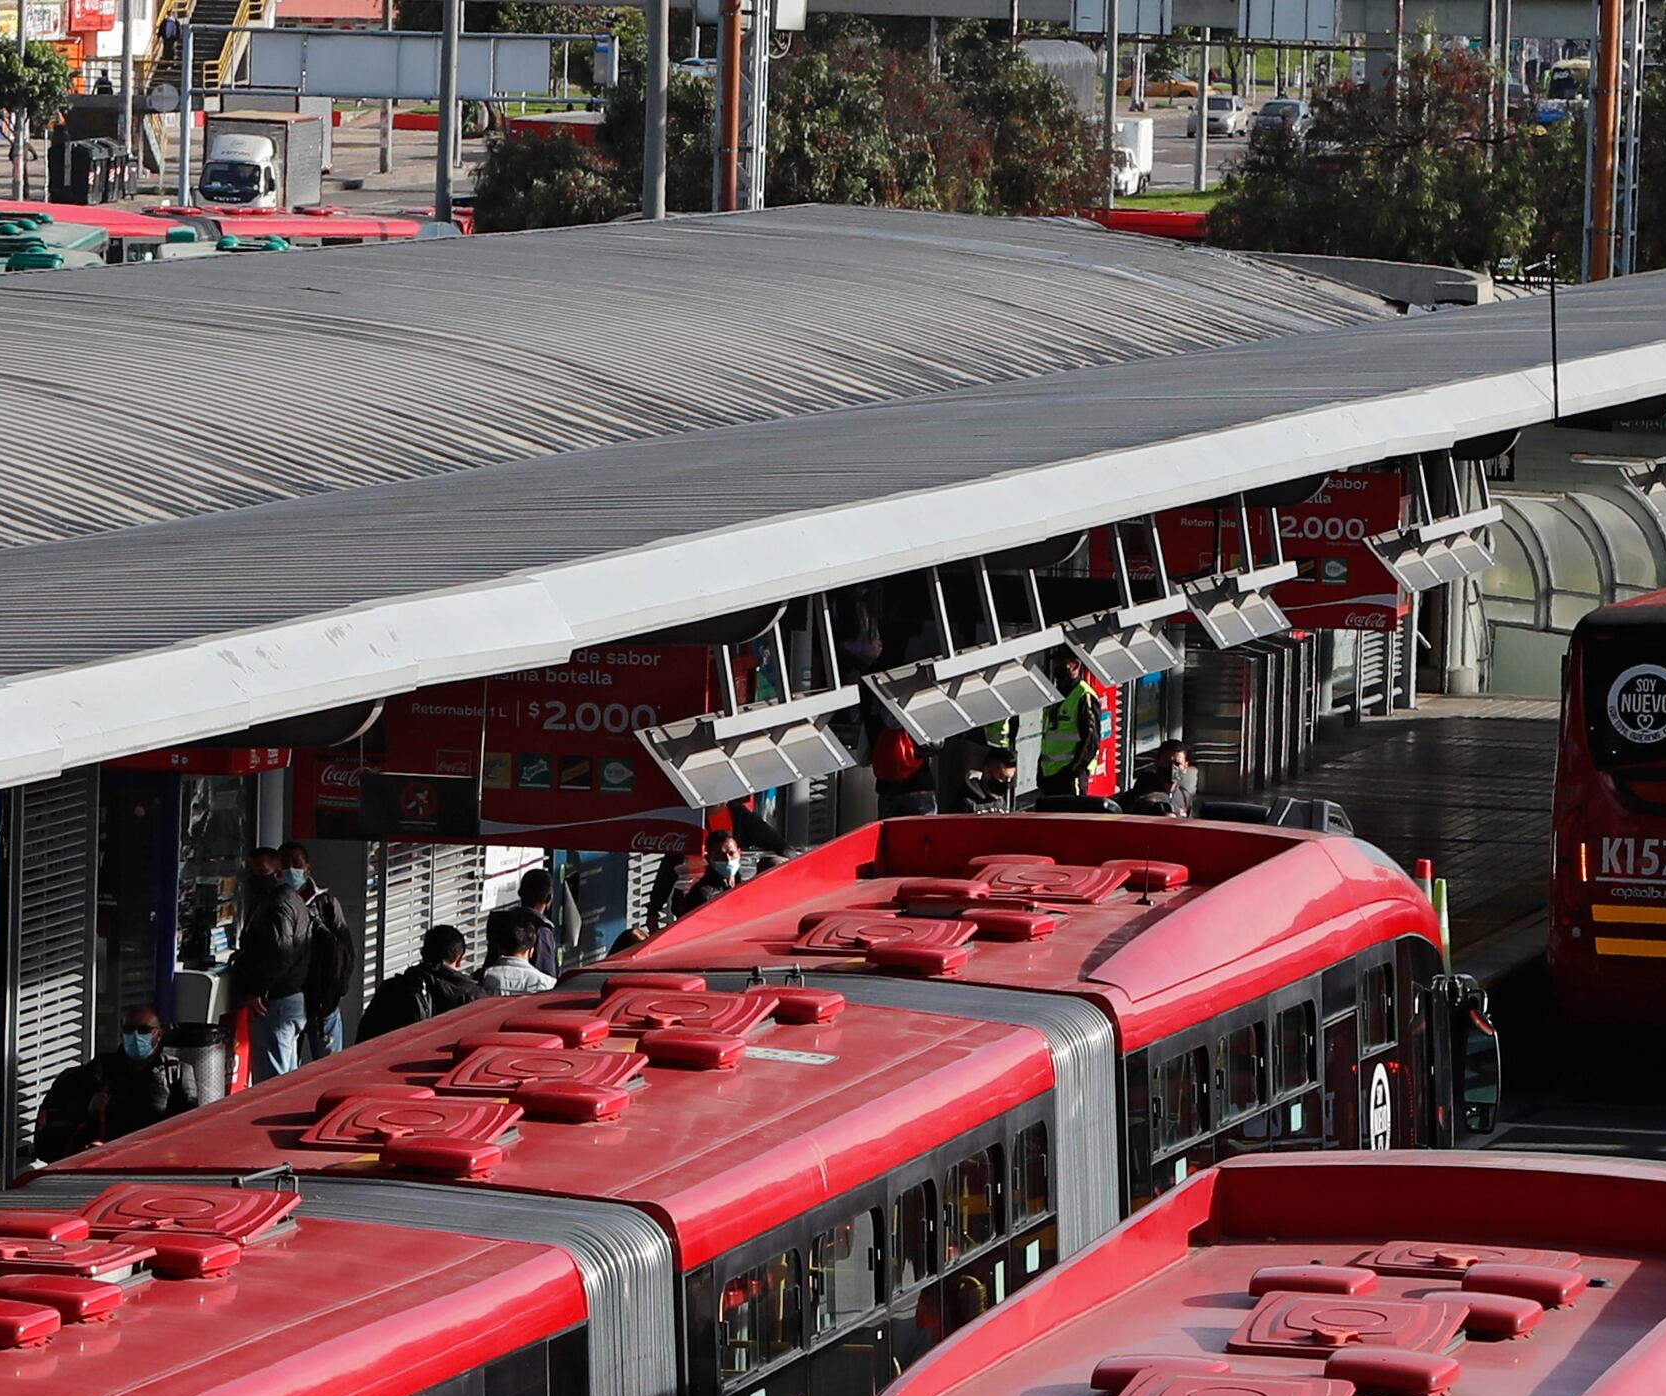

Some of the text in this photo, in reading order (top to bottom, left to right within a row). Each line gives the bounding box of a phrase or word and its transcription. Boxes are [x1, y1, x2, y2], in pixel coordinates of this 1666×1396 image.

[1327, 478, 1368, 491] sabor
[1180, 517, 1237, 529] Retornble
[576, 650, 661, 666] de sabor
[545, 669, 613, 685] botella
[1635, 678, 1657, 693] SOY
[411, 703, 482, 718] Retornable
